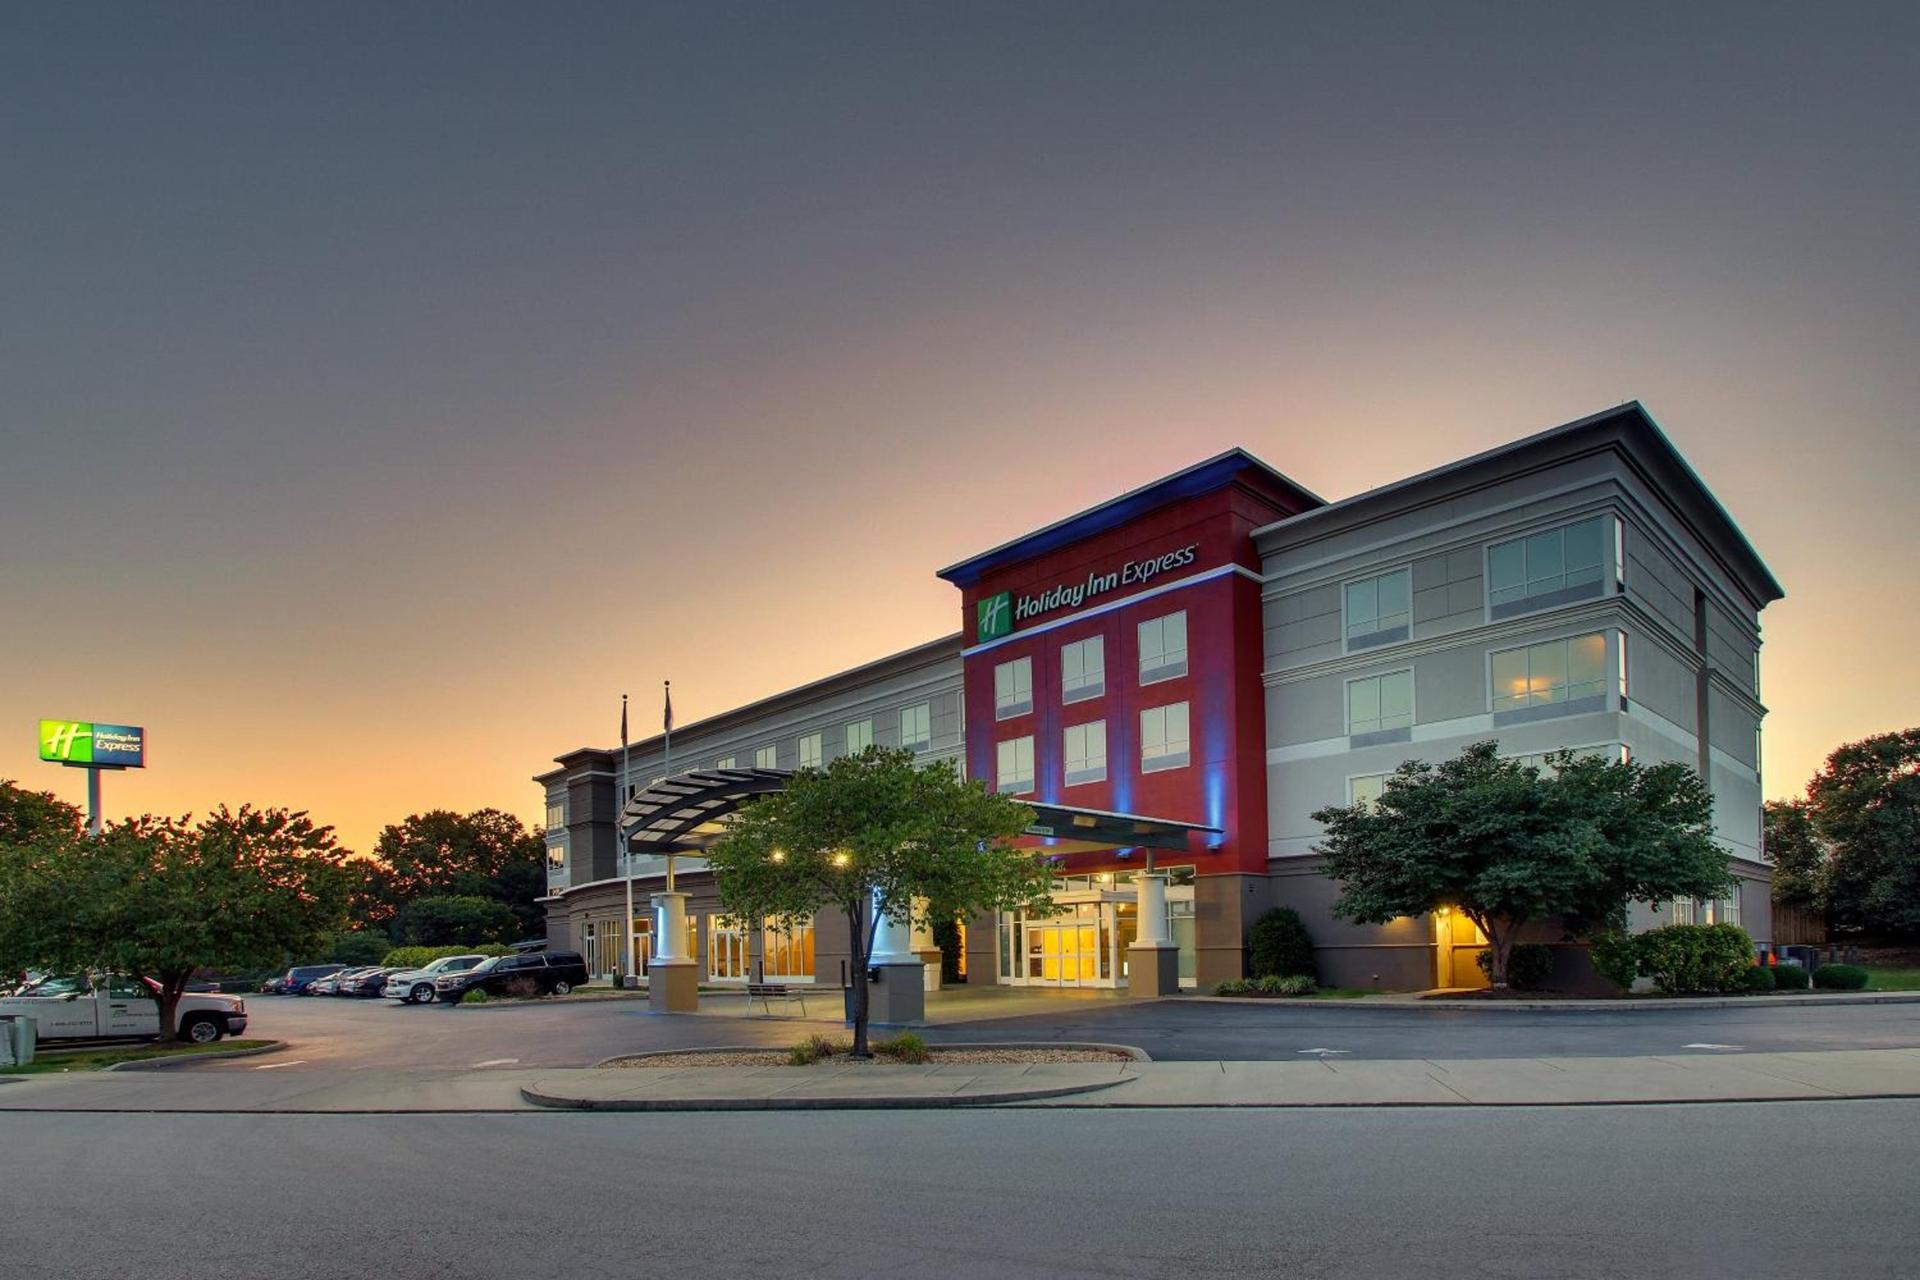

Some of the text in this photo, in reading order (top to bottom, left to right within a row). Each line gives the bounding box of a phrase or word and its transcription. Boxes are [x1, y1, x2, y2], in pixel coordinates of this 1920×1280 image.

[1015, 545, 1196, 620] Holiday Inn Express
[96, 732, 140, 742] Holiday Inn
[96, 740, 141, 752] Express
